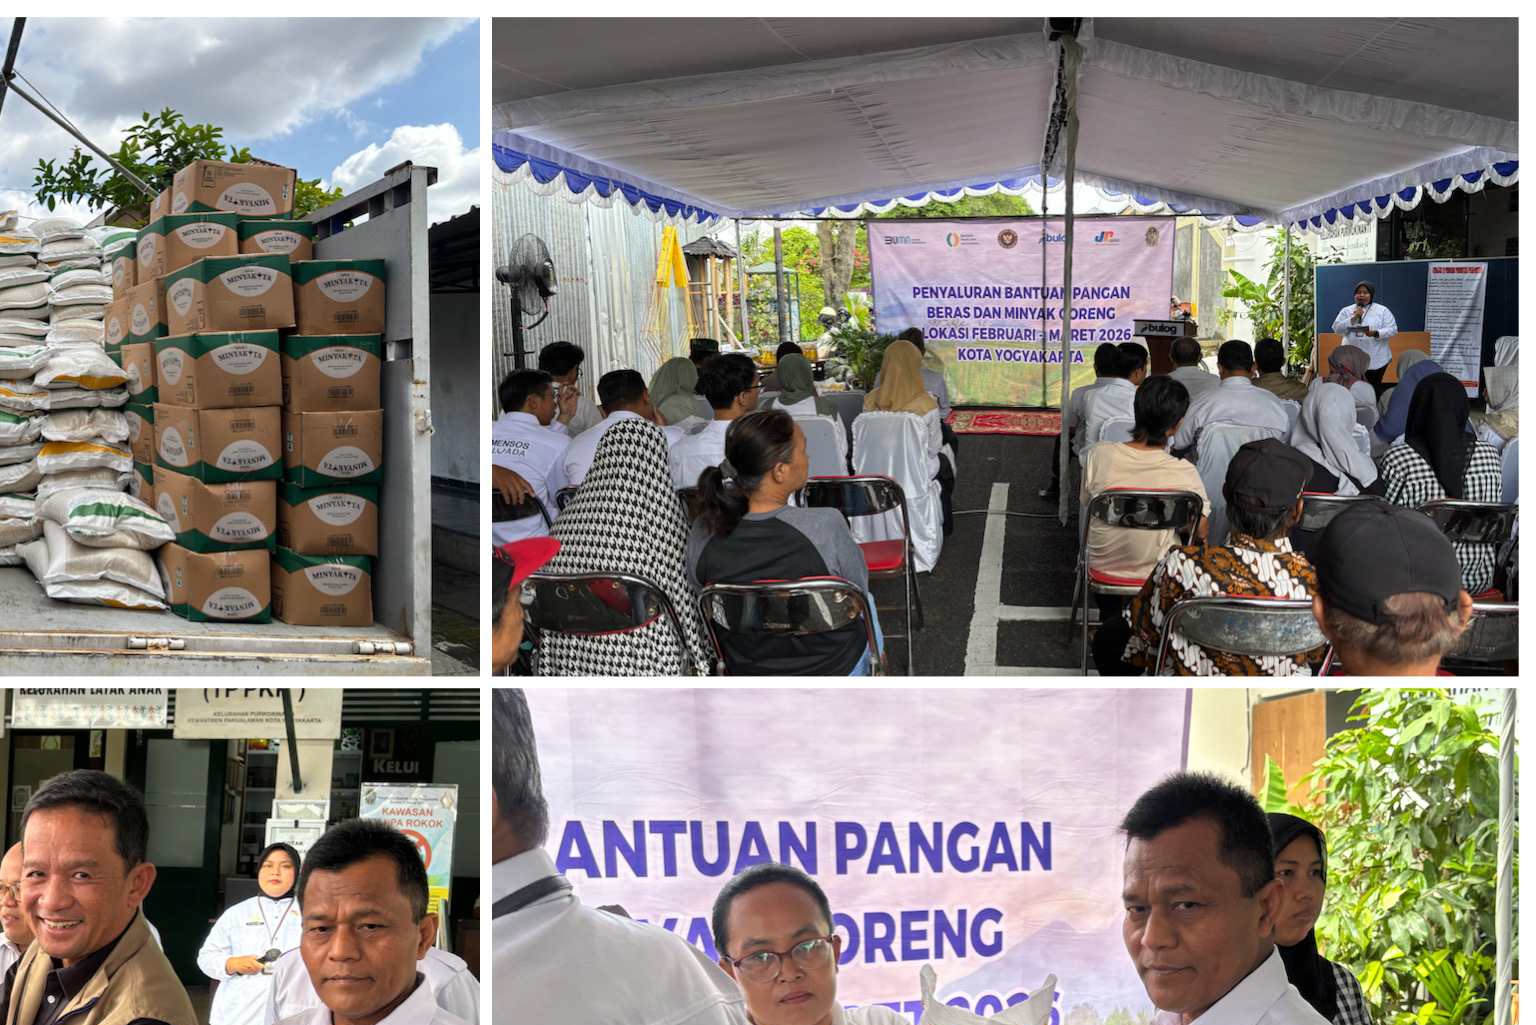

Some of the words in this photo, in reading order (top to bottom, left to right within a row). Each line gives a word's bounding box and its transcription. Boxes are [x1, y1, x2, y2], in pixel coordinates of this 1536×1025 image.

[913, 286, 1002, 299] PENYALURAN
[1072, 287, 1130, 300] PANGAN
[927, 306, 970, 319] BERAS
[974, 306, 1002, 319] DAN
[1004, 307, 1055, 320] MINYAK
[923, 327, 969, 340] LOKASI
[972, 328, 1036, 340] FEBRUARI
[1099, 328, 1131, 341] 2026
[1148, 323, 1177, 334] bulog
[958, 348, 992, 361] KOTA
[382, 808, 433, 817] KAWASAN
[406, 819, 444, 828] ROKOK
[556, 820, 818, 879] ANTUAN
[835, 820, 1053, 875] PANGAN
[834, 907, 1003, 966] ORENG
